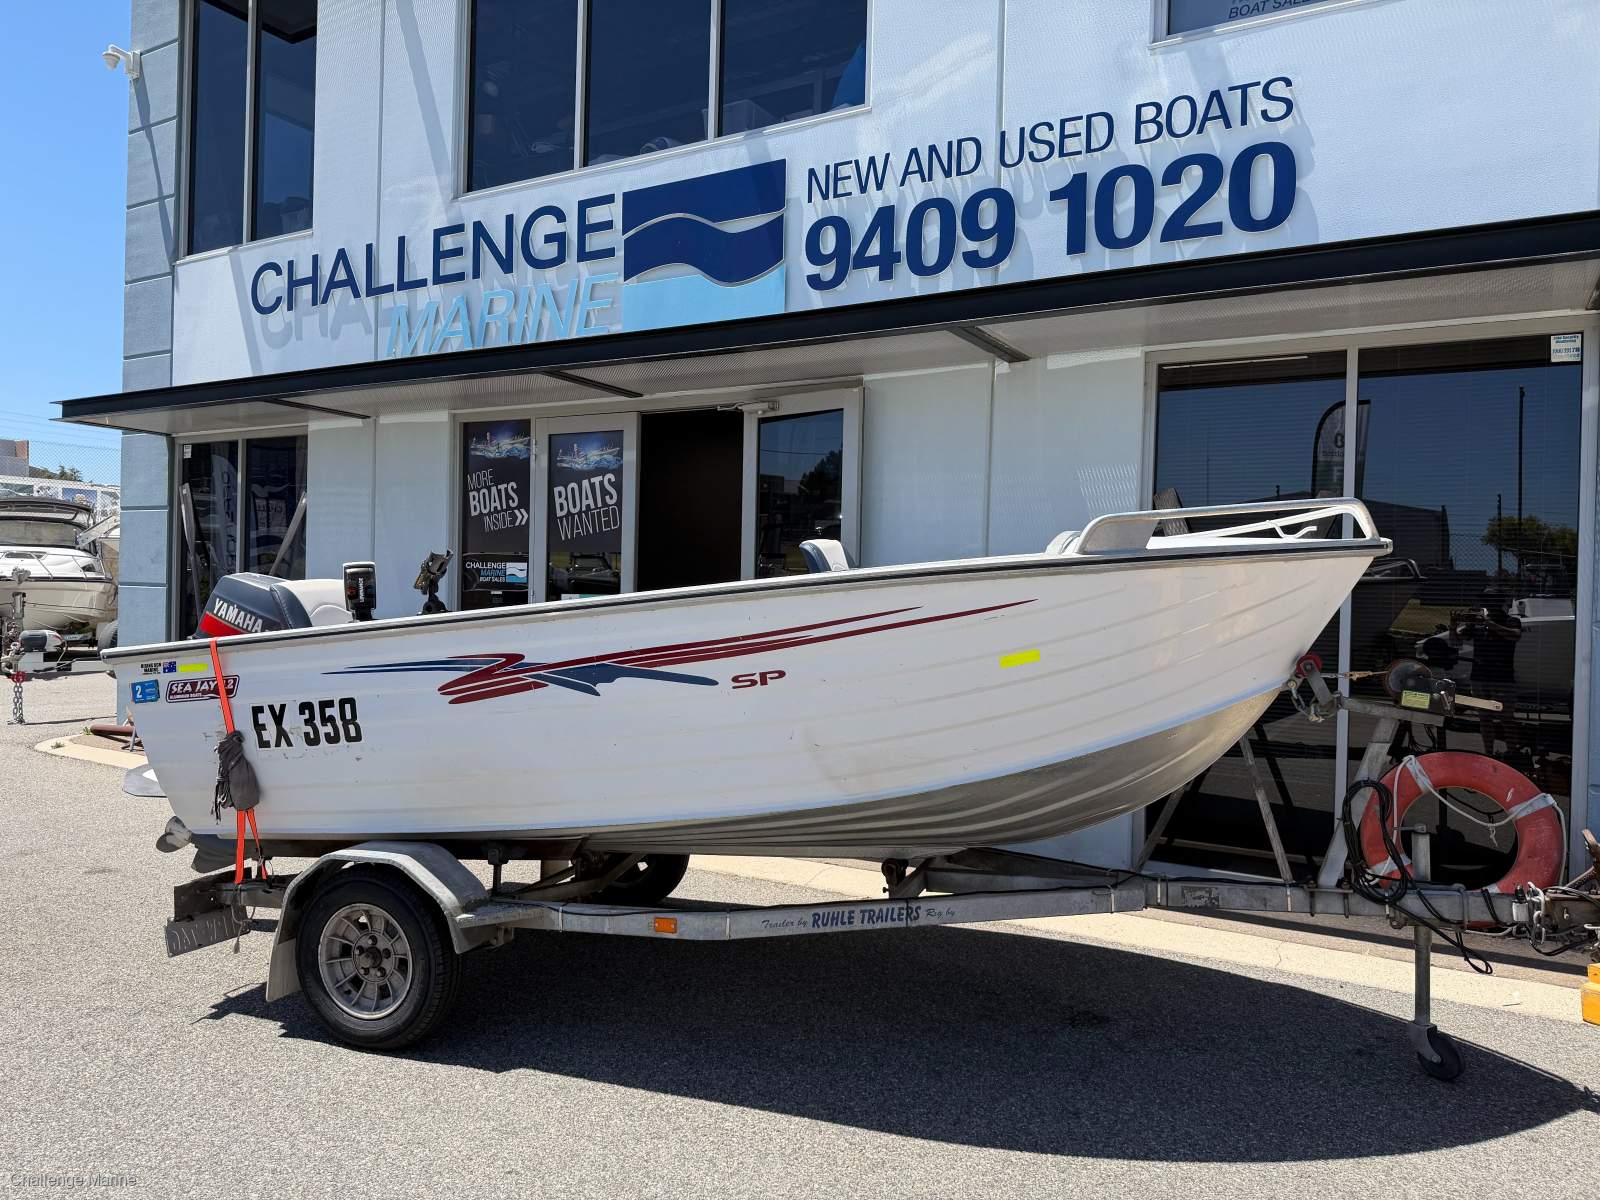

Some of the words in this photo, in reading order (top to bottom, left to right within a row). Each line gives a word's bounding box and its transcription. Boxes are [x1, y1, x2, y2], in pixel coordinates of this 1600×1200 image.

[1228, 0, 1267, 19] BOAT
[807, 152, 892, 204] NEW
[899, 136, 982, 188] AND
[1000, 111, 1115, 169] USED
[1134, 75, 1294, 146] BOATS
[804, 187, 1016, 292] 9409
[1049, 141, 1297, 257] 1020
[250, 193, 617, 316] CHALLENGE
[384, 272, 619, 358] MARINE
[467, 468, 495, 491] MORE
[469, 481, 519, 516] BOATS
[554, 473, 618, 517] BOATS
[484, 510, 513, 532] INSIDE
[557, 505, 620, 541] WANTED
[465, 561, 506, 570] CHALLENGE
[480, 569, 506, 577] MARINE
[213, 597, 263, 633] YAMAHA
[135, 684, 143, 699] 2
[171, 682, 192, 694] SEA
[195, 680, 218, 693] JAY
[731, 669, 786, 690] SP
[251, 703, 294, 749] EX
[298, 697, 362, 747] 358
[761, 919, 794, 929] Trailer
[812, 910, 855, 928] RUHLE
[860, 906, 922, 925] TRAILERS
